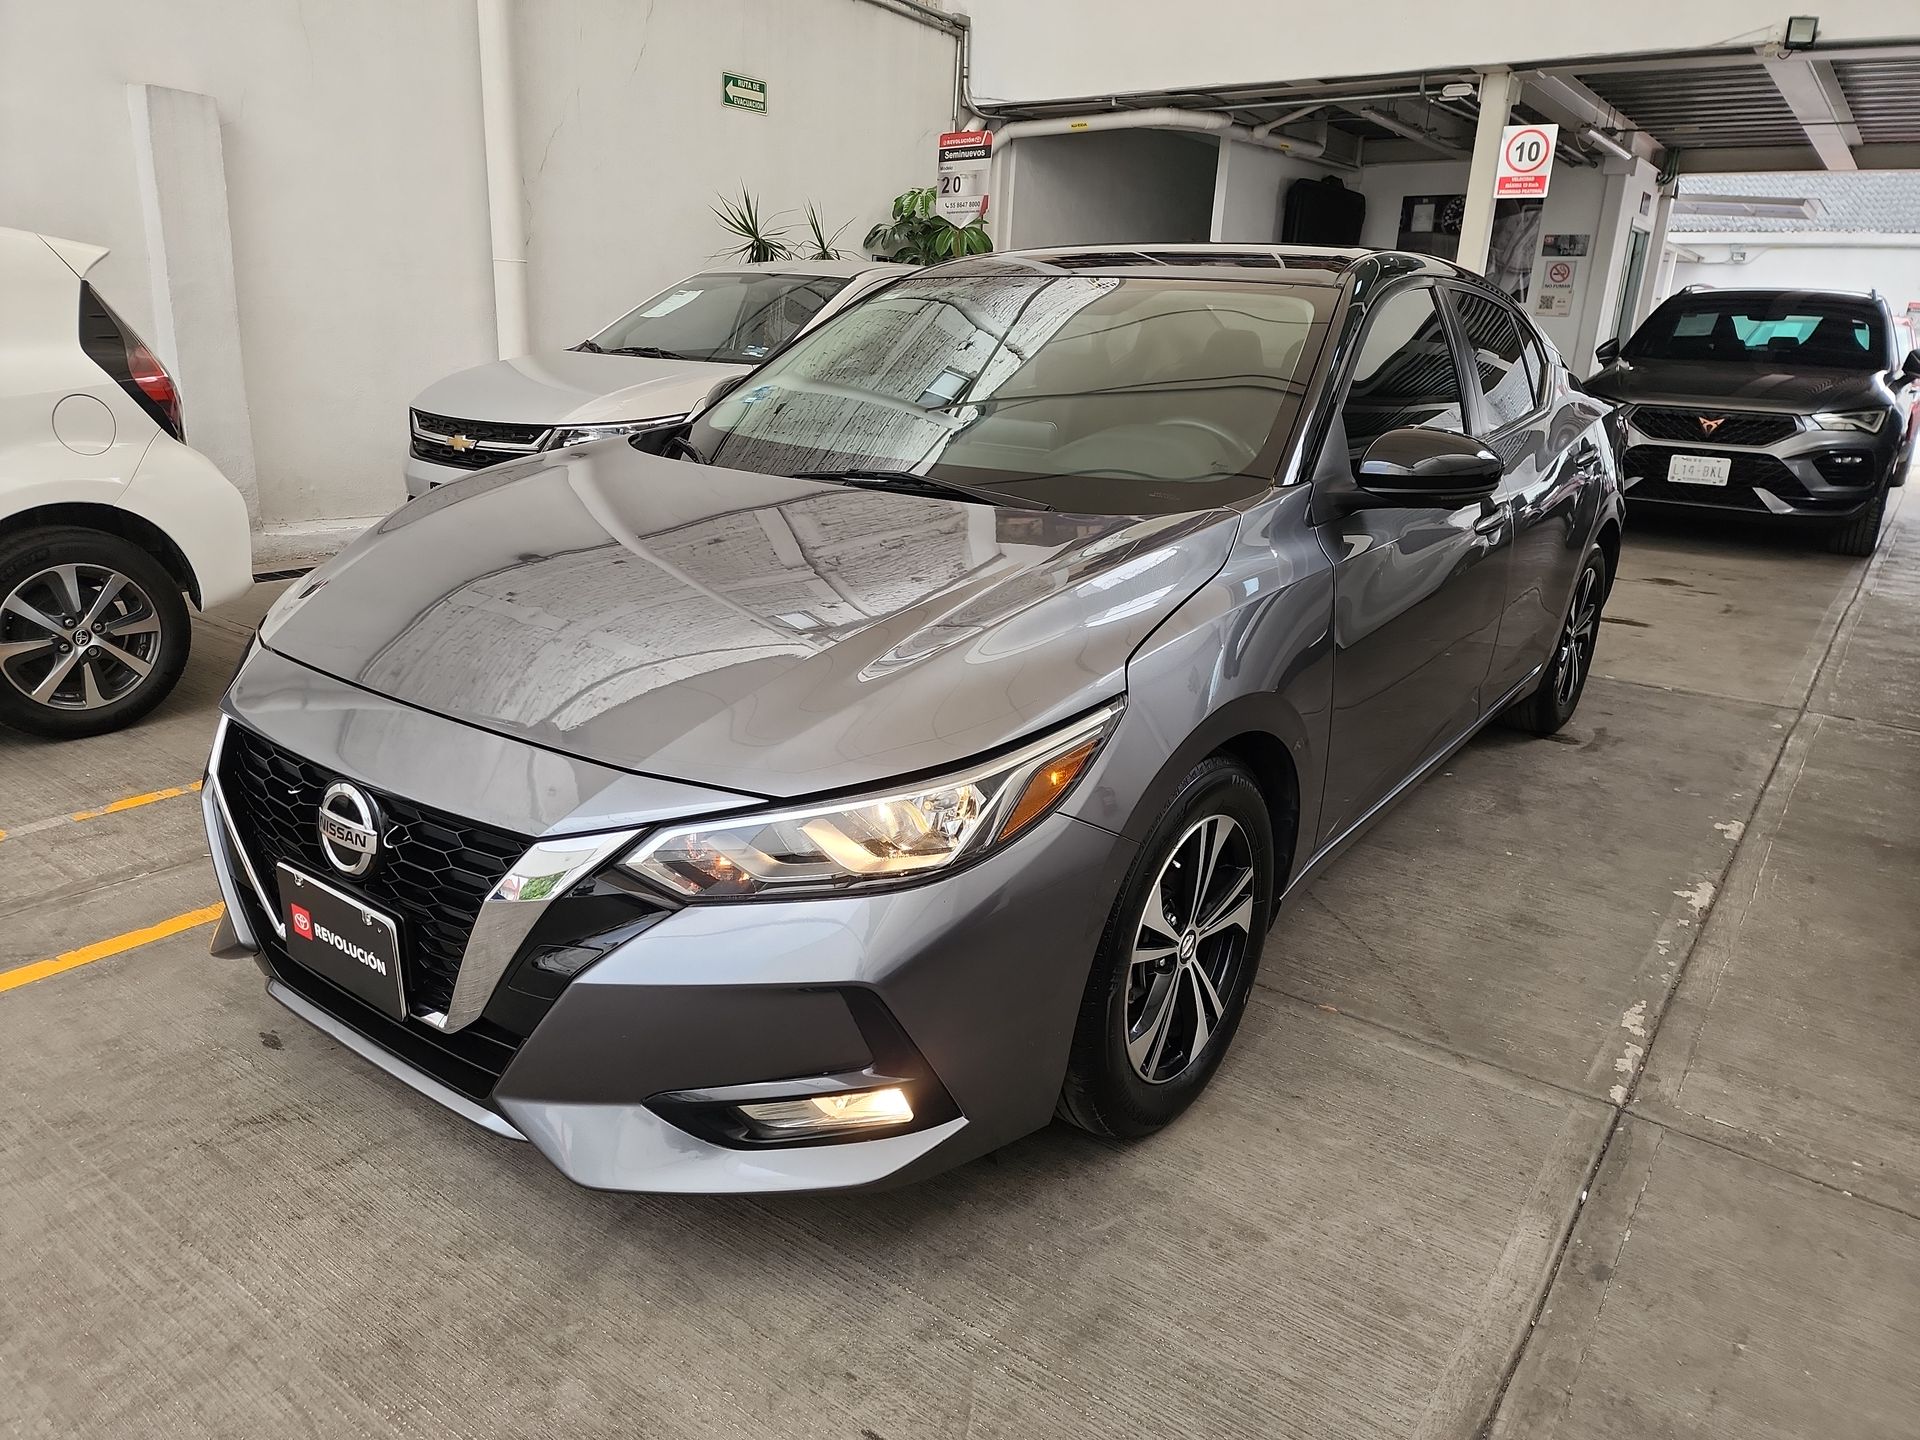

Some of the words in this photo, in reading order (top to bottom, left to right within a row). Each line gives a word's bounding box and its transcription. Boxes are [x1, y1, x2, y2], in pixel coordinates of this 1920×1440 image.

[738, 80, 752, 89] RUTA
[752, 83, 760, 91] DE
[944, 149, 986, 159] Seminuevos
[1515, 141, 1541, 162] 10
[319, 815, 367, 849] NISSAN
[313, 922, 387, 977] REVOLUCIÓN
